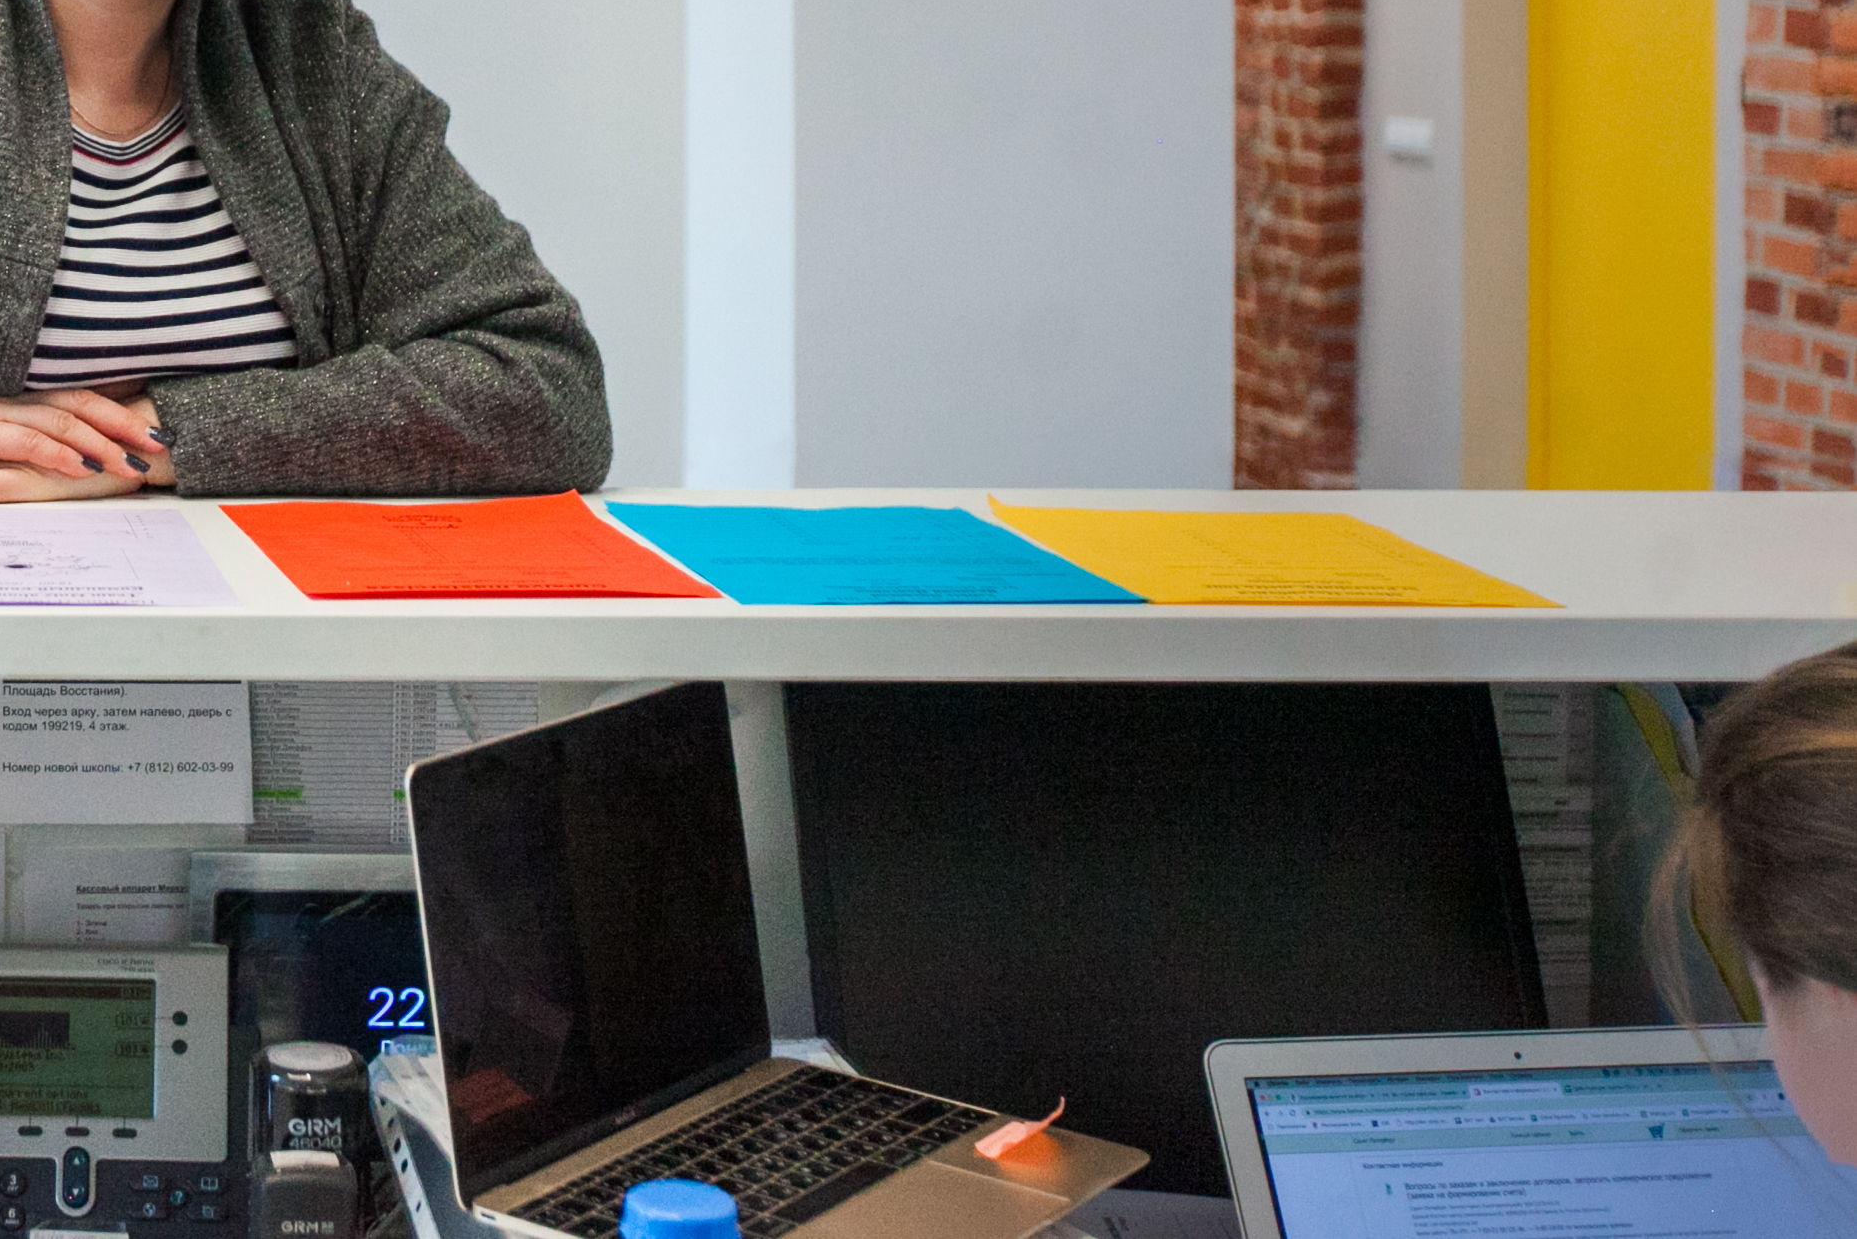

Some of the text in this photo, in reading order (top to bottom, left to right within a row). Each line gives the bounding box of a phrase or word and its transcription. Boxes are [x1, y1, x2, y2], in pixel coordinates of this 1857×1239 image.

[2, 684, 128, 698] Площадь Восстания).
[2, 706, 233, 719] Вход через арку, затем налево, дверь с
[2, 721, 130, 733] кодом 199219, 4 этаж.
[2, 762, 234, 775] Номер новой школы: +7 (812) 602-03-99
[76, 884, 156, 894] Кассовый аппарат
[288, 1117, 341, 1136] GRM
[9, 1174, 17, 1186] 3
[1404, 1181, 1437, 1191] Вопросы
[8, 1208, 16, 1219] 6
[281, 1220, 319, 1234] GRM
